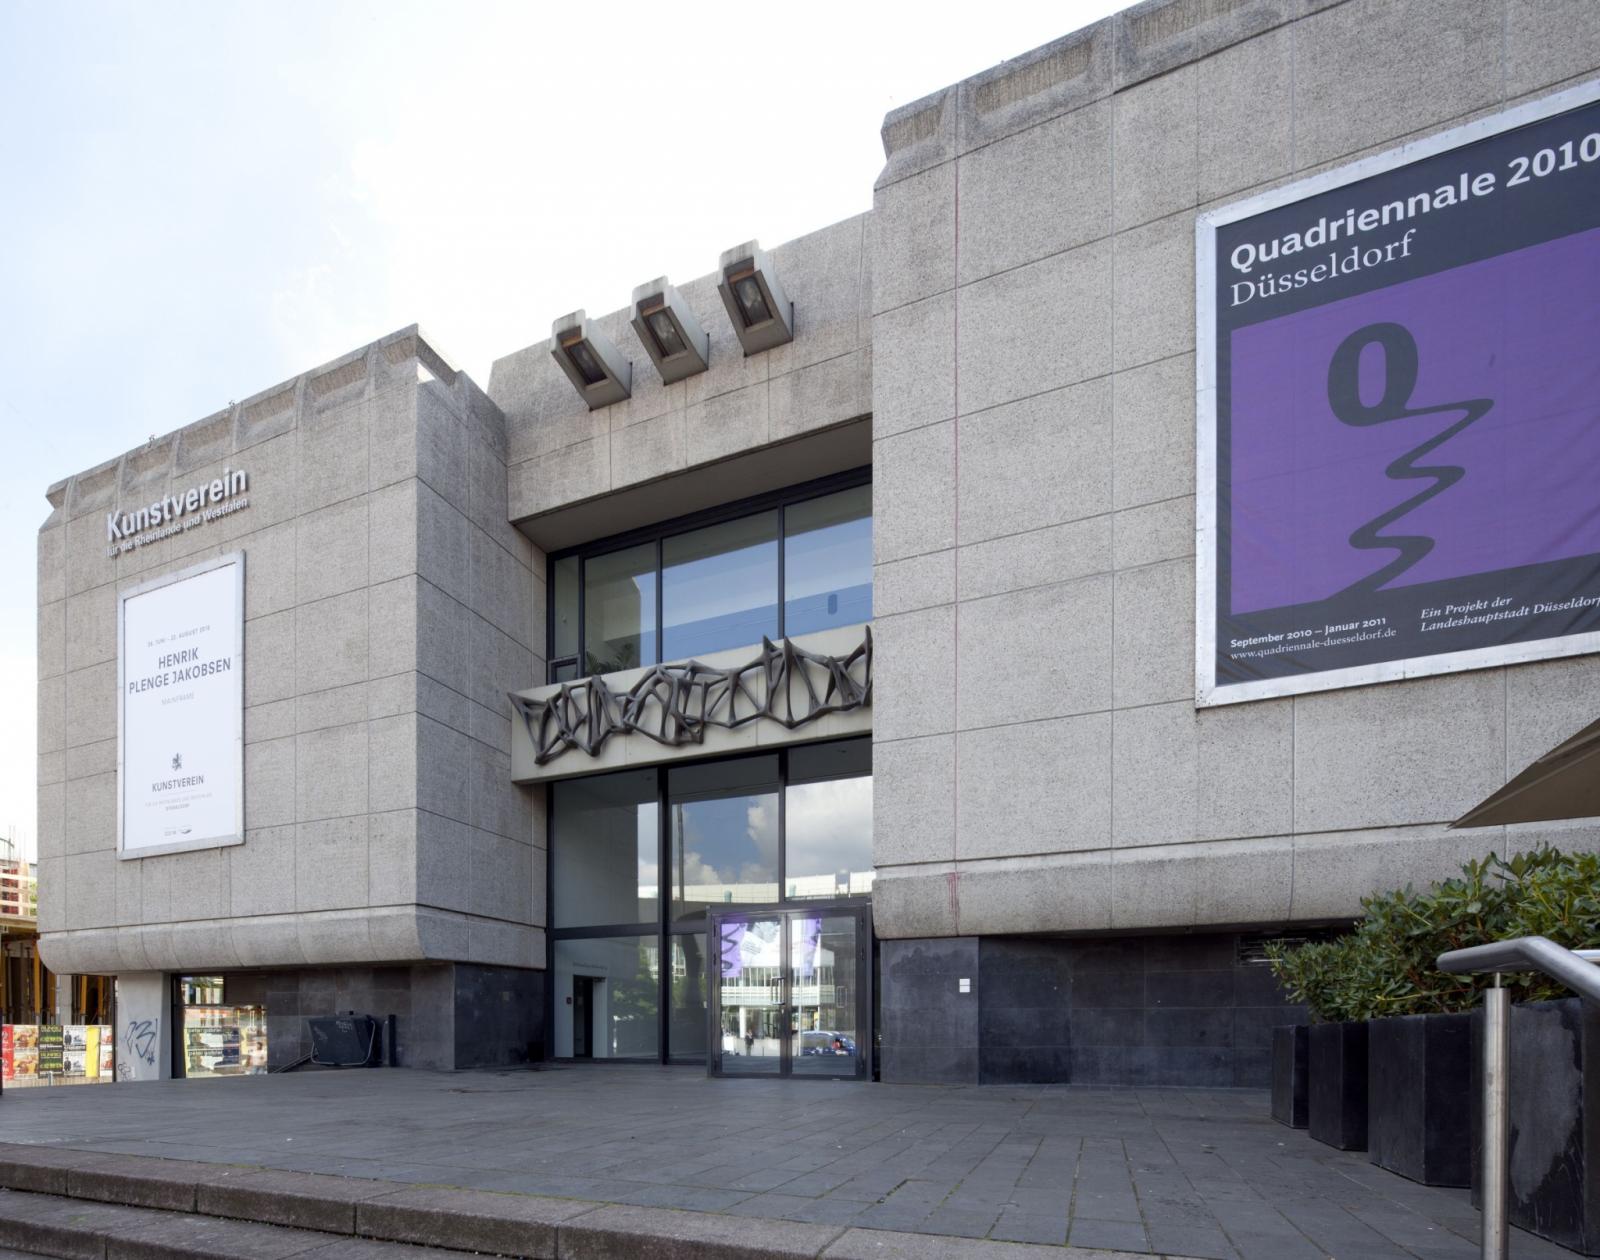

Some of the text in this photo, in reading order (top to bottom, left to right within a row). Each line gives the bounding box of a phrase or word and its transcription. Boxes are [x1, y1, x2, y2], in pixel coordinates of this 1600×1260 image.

[1230, 132, 1600, 272] Quadriennale 2010
[1231, 229, 1416, 306] Düsseldorf
[107, 468, 248, 542] Kunstverein
[134, 522, 181, 548] Rheinlande
[183, 515, 201, 529] und
[202, 498, 248, 521] Westfalen
[1420, 597, 1513, 619] Ein Projekt der
[1421, 607, 1530, 632] Landeshauptstadt
[1230, 634, 1285, 649] September
[1286, 629, 1312, 640] 2010
[1325, 622, 1360, 635] Januar
[1362, 617, 1386, 628] 2011
[1230, 628, 1397, 660] www.quadriennale-duesseldorf.de
[158, 647, 199, 669] HENRIK
[129, 657, 231, 695] PLENGE JAKOBSEN
[151, 775, 204, 793] KUNSTVEREIN
